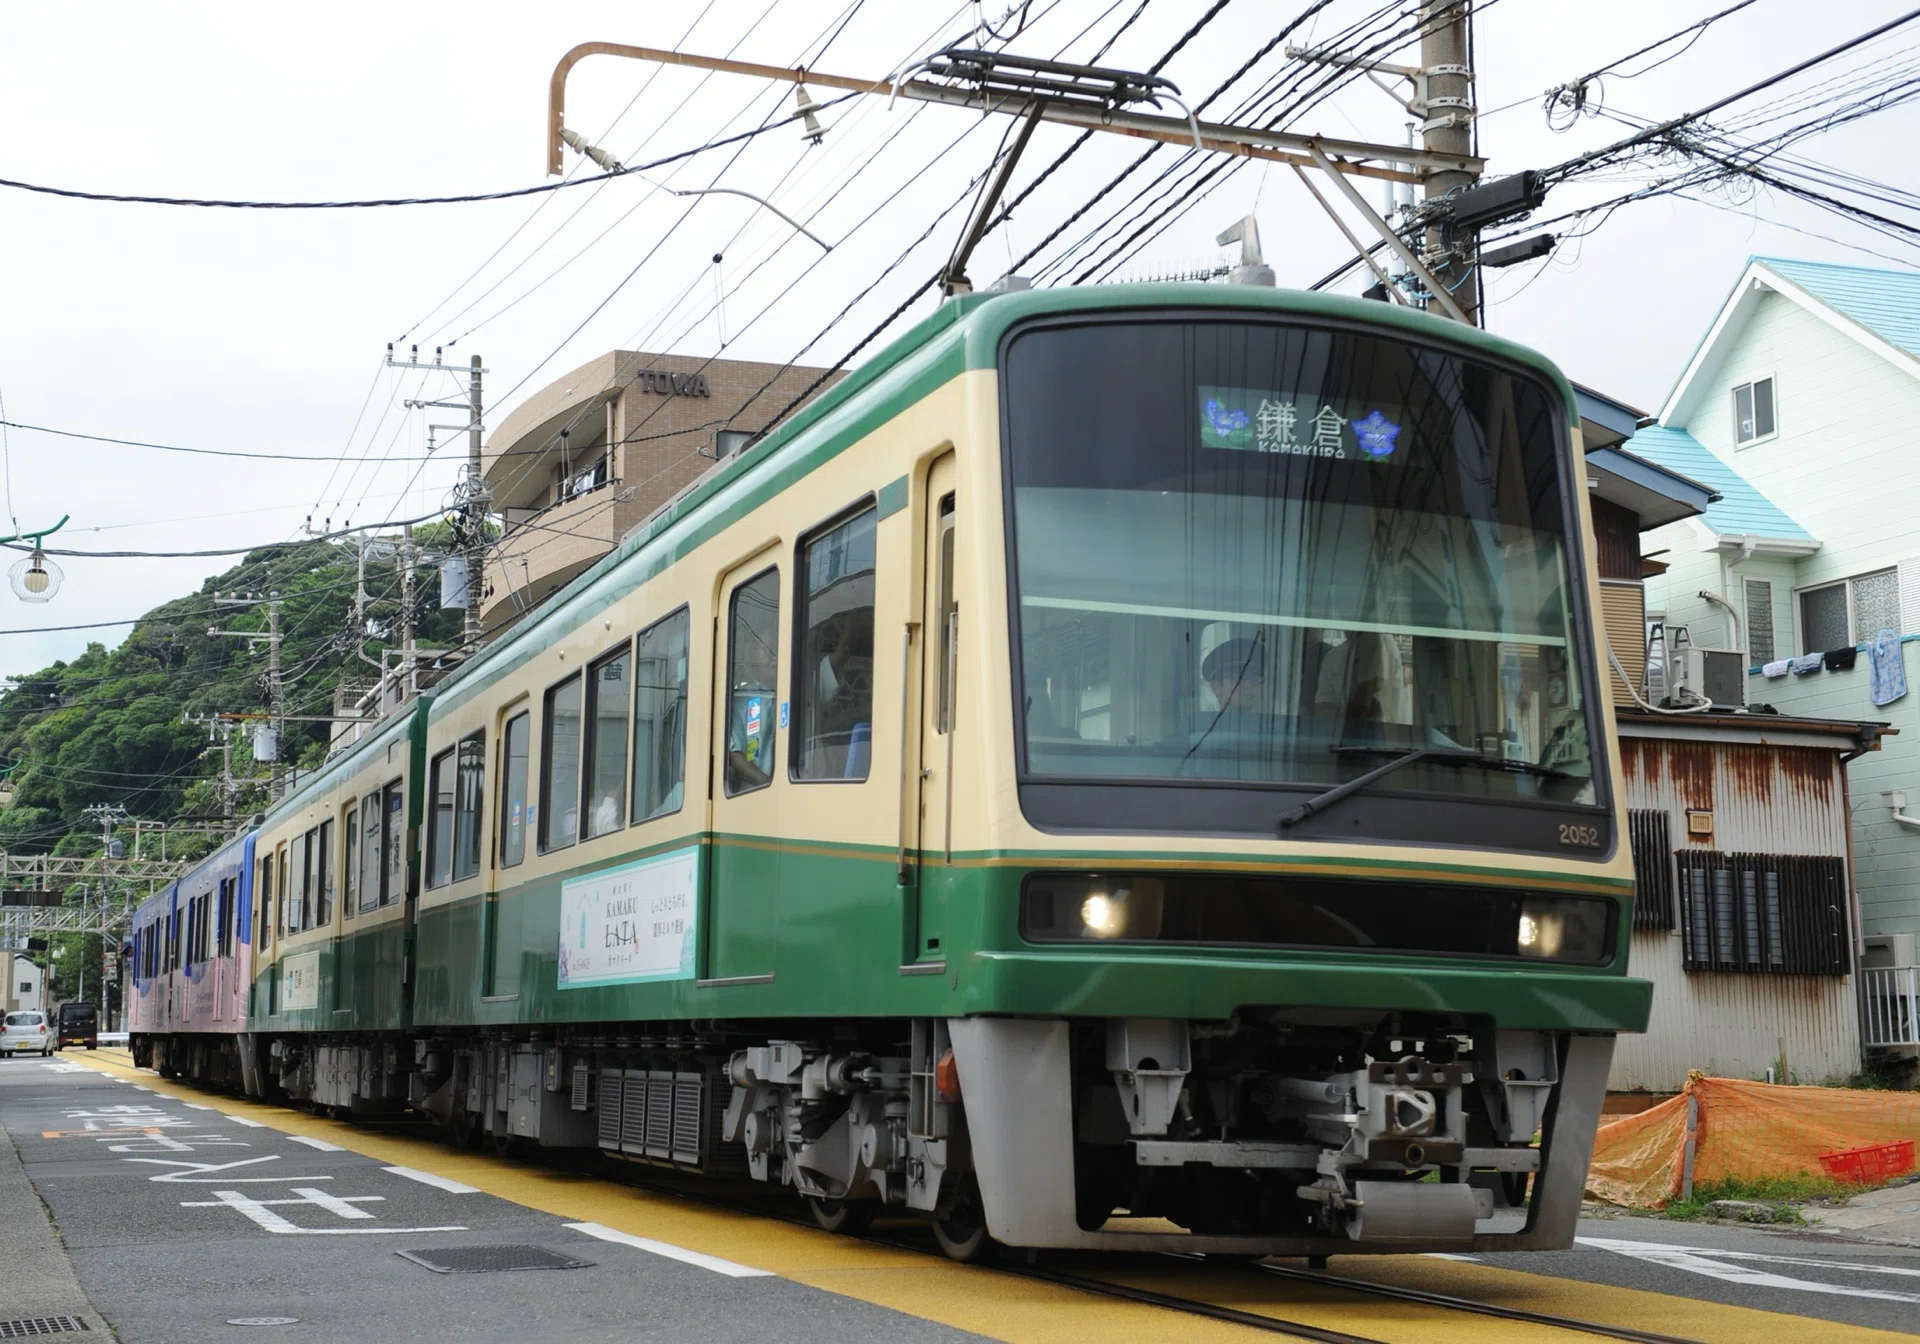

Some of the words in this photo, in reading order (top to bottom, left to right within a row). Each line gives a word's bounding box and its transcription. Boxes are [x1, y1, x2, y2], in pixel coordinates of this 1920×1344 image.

[638, 369, 710, 398] TOWA
[1256, 399, 1348, 448] 鎌倉
[1559, 824, 1599, 846] 2052
